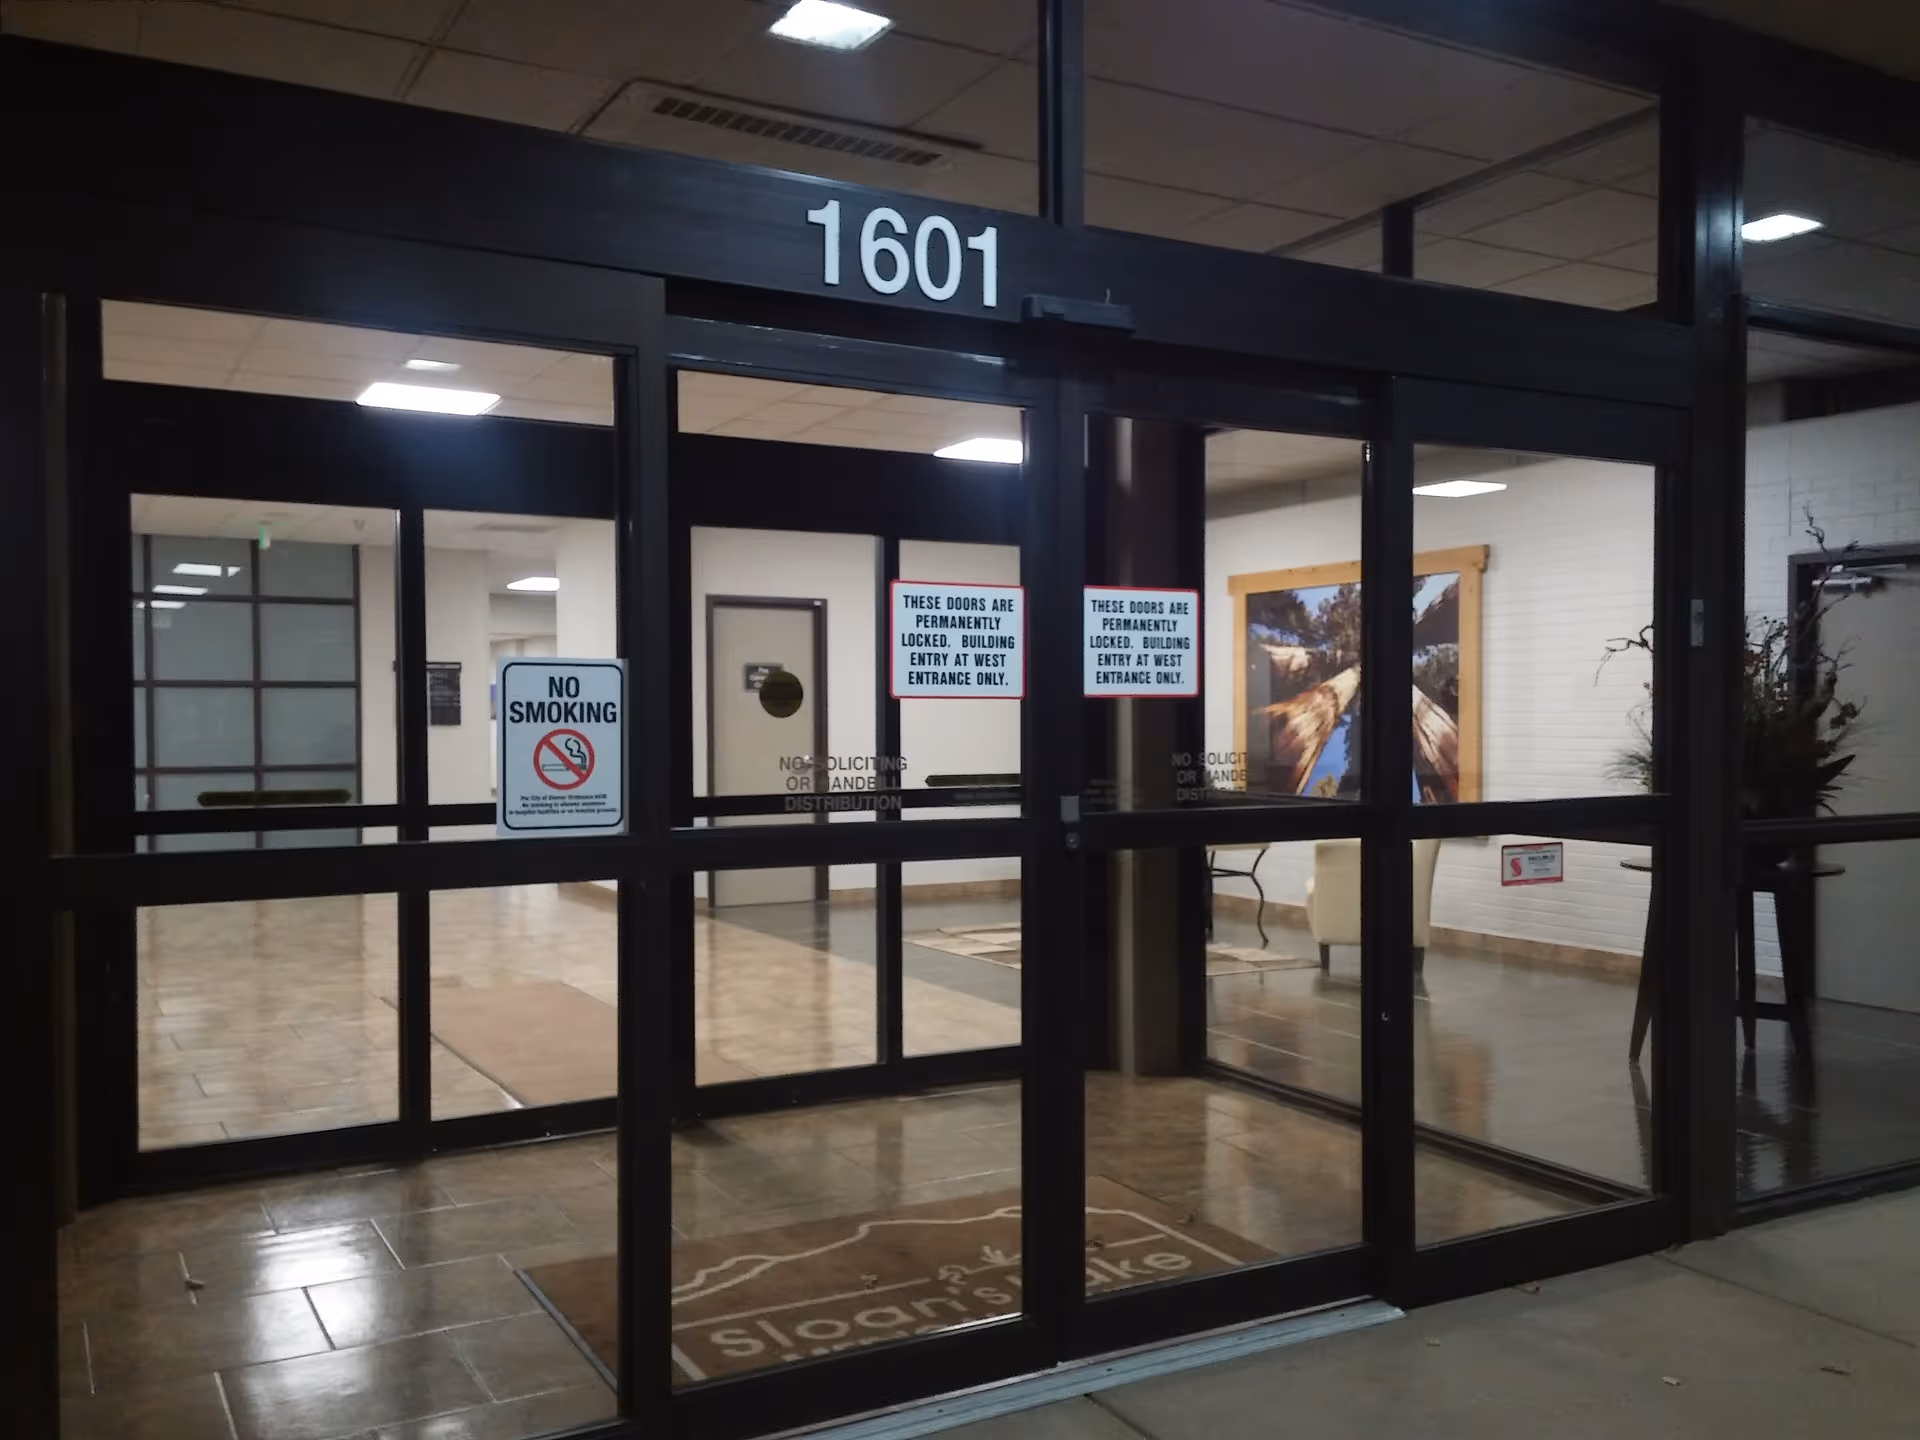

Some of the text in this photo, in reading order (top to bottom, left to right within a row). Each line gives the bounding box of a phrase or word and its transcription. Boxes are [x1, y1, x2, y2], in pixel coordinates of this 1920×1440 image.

[807, 199, 998, 308] 1601
[903, 595, 1014, 612] THESE DOORS ARE
[1091, 600, 1189, 615] THESE DOORS ARE
[916, 614, 1001, 630] PERMANENTLY
[1102, 618, 1178, 632] PERMANENTLY
[902, 633, 1015, 649] LOCKED. BUILDING
[1090, 636, 1190, 650] LOCKED. BUILDING
[910, 652, 1006, 667] ENTRY AT WEST
[1098, 654, 1183, 667] ENTRY AT WEST
[908, 671, 1008, 686] ENTRANCE ONLY.
[1096, 671, 1185, 684] ENTRANCE ONLY.
[548, 676, 580, 698] NO
[509, 700, 617, 724] SMOKING
[780, 756, 804, 771] NO
[1170, 752, 1192, 767] NO
[786, 776, 901, 791] OR ANDBILL
[1176, 770, 1198, 784] OR
[784, 794, 902, 812] DISTRIBUTION
[709, 1286, 1013, 1358] Sloan's
